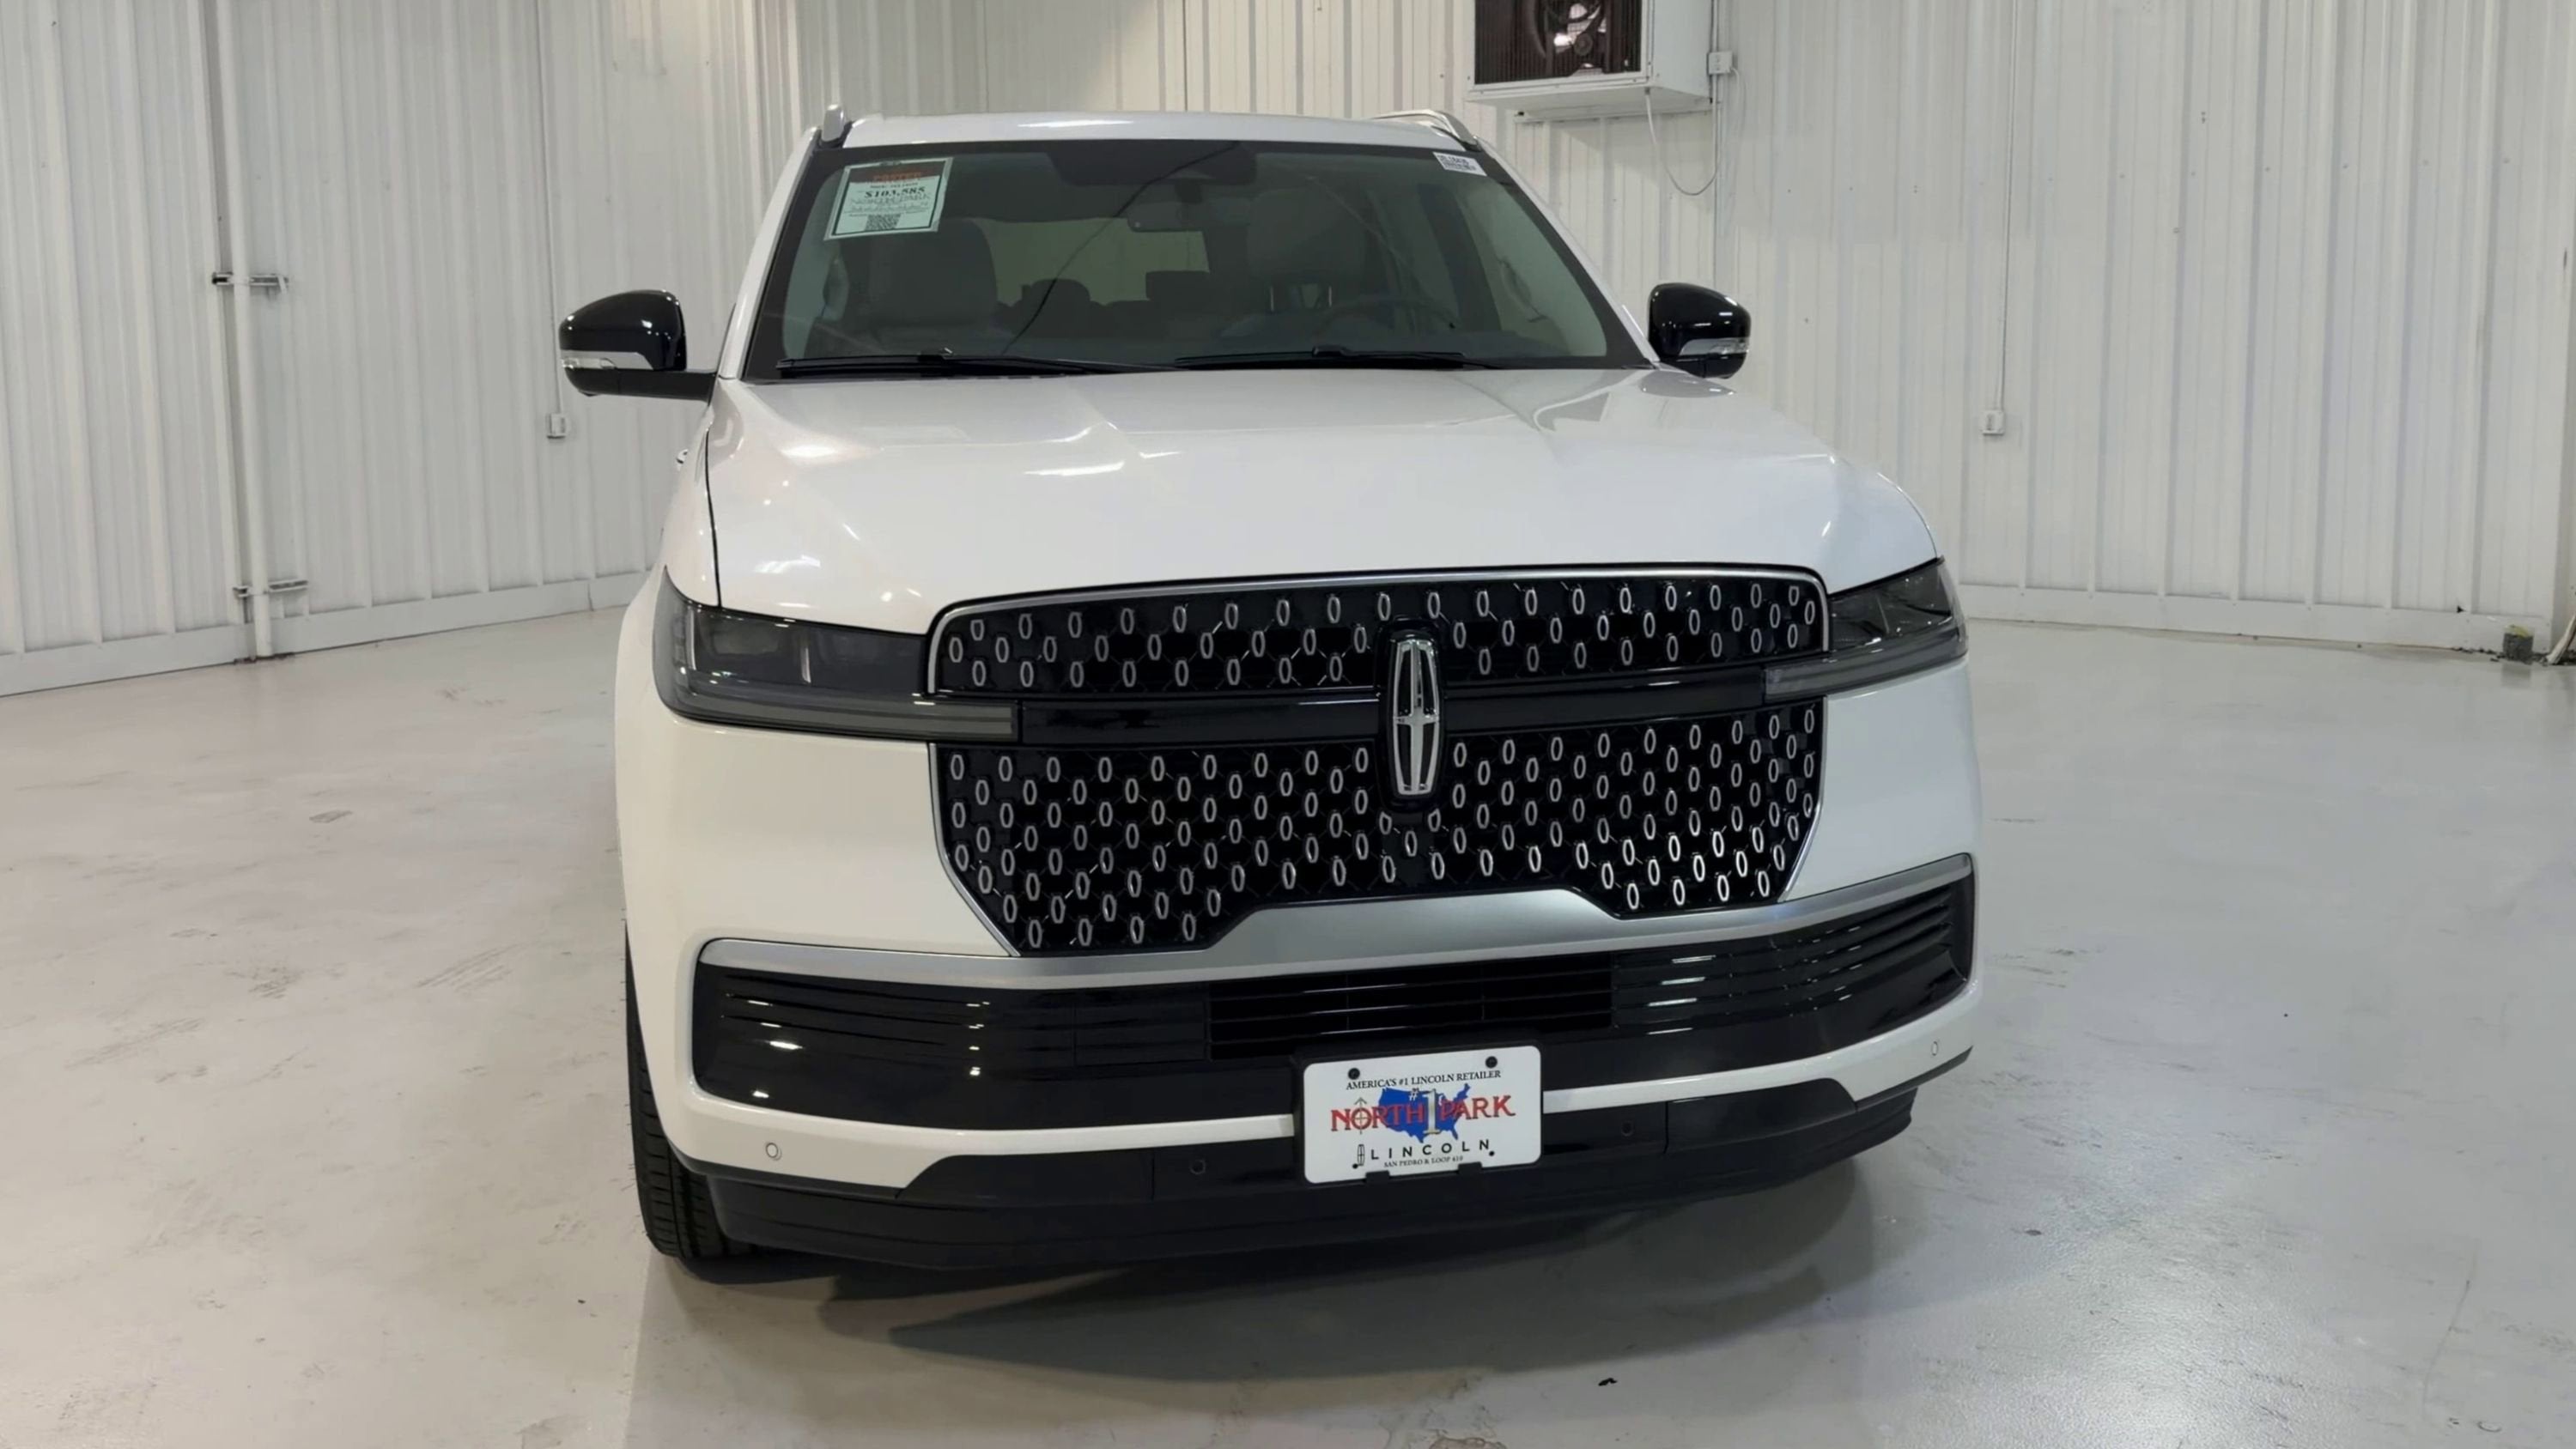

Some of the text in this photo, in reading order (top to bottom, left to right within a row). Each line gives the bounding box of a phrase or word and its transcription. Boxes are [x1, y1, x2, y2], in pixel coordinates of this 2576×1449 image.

[1346, 1070, 1501, 1090] AMERICA'S #1 LINCOLN RETAILER
[1331, 1094, 1516, 1131] NORTH PARK
[1370, 1139, 1489, 1160] LINCOLN
